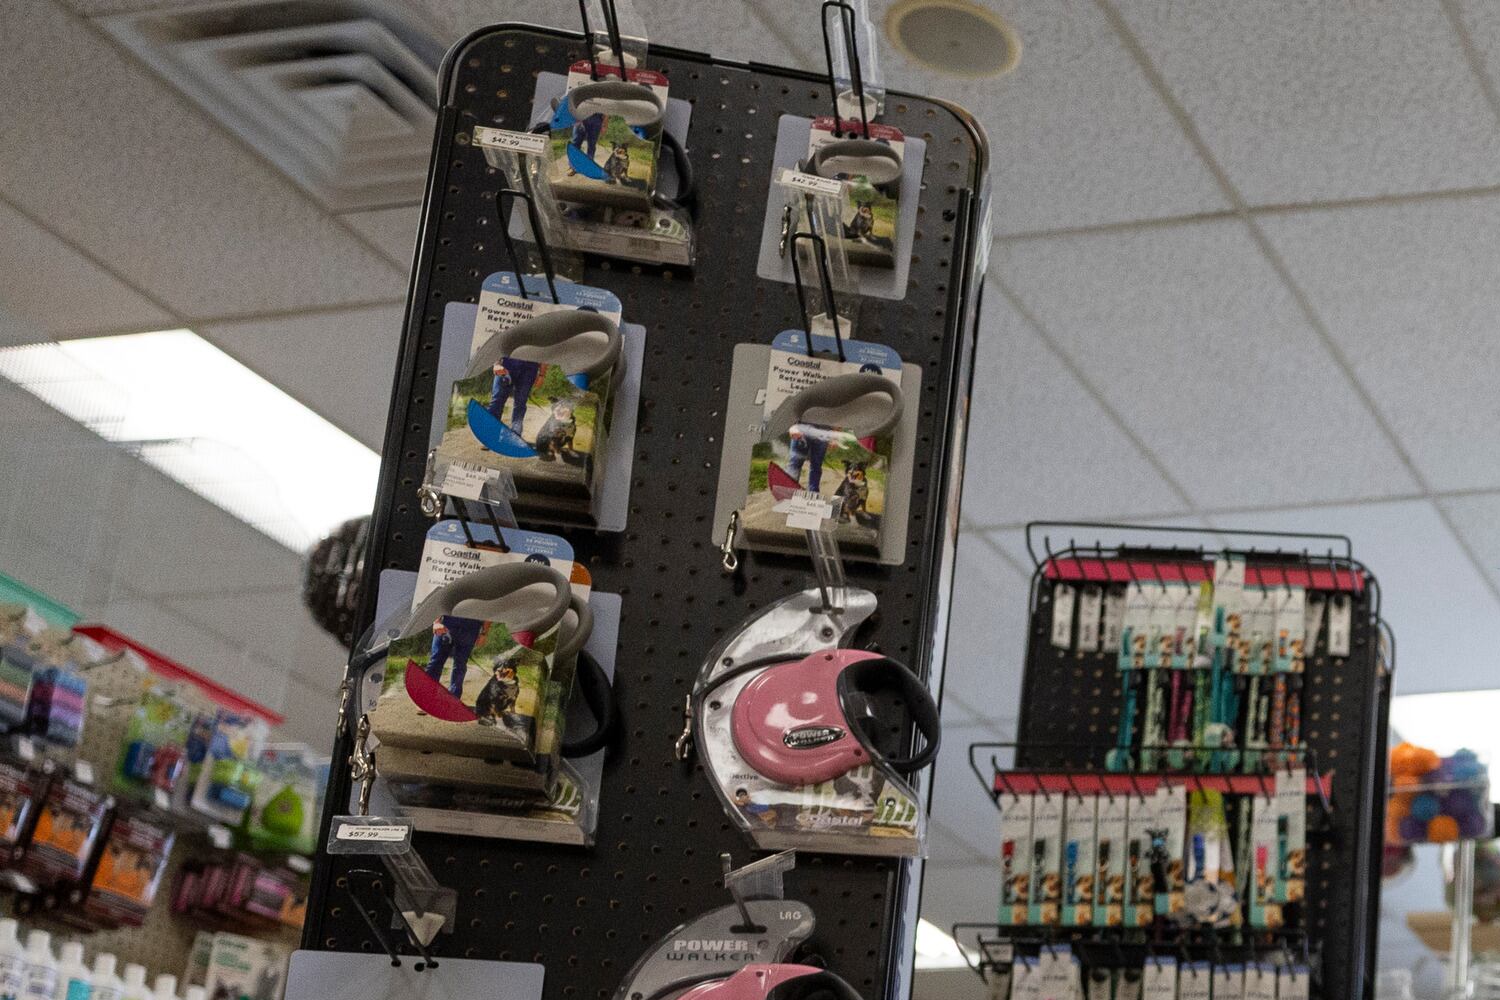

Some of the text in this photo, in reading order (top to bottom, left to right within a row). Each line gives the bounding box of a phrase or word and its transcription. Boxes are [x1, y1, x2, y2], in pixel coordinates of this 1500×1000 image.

[491, 136, 520, 147] $42.99
[501, 275, 511, 285] S
[497, 298, 534, 311] Coastal
[481, 306, 534, 320] Power Walk
[487, 315, 520, 325] Retract
[787, 356, 821, 370] Coastal
[773, 365, 800, 375] Power
[447, 523, 458, 533] S
[443, 547, 481, 562] Coastal
[425, 556, 487, 570] Power Walke
[795, 811, 863, 828] Coastal
[780, 911, 802, 920] LRG
[674, 939, 748, 951] POWER
[666, 951, 755, 962] WALKER
